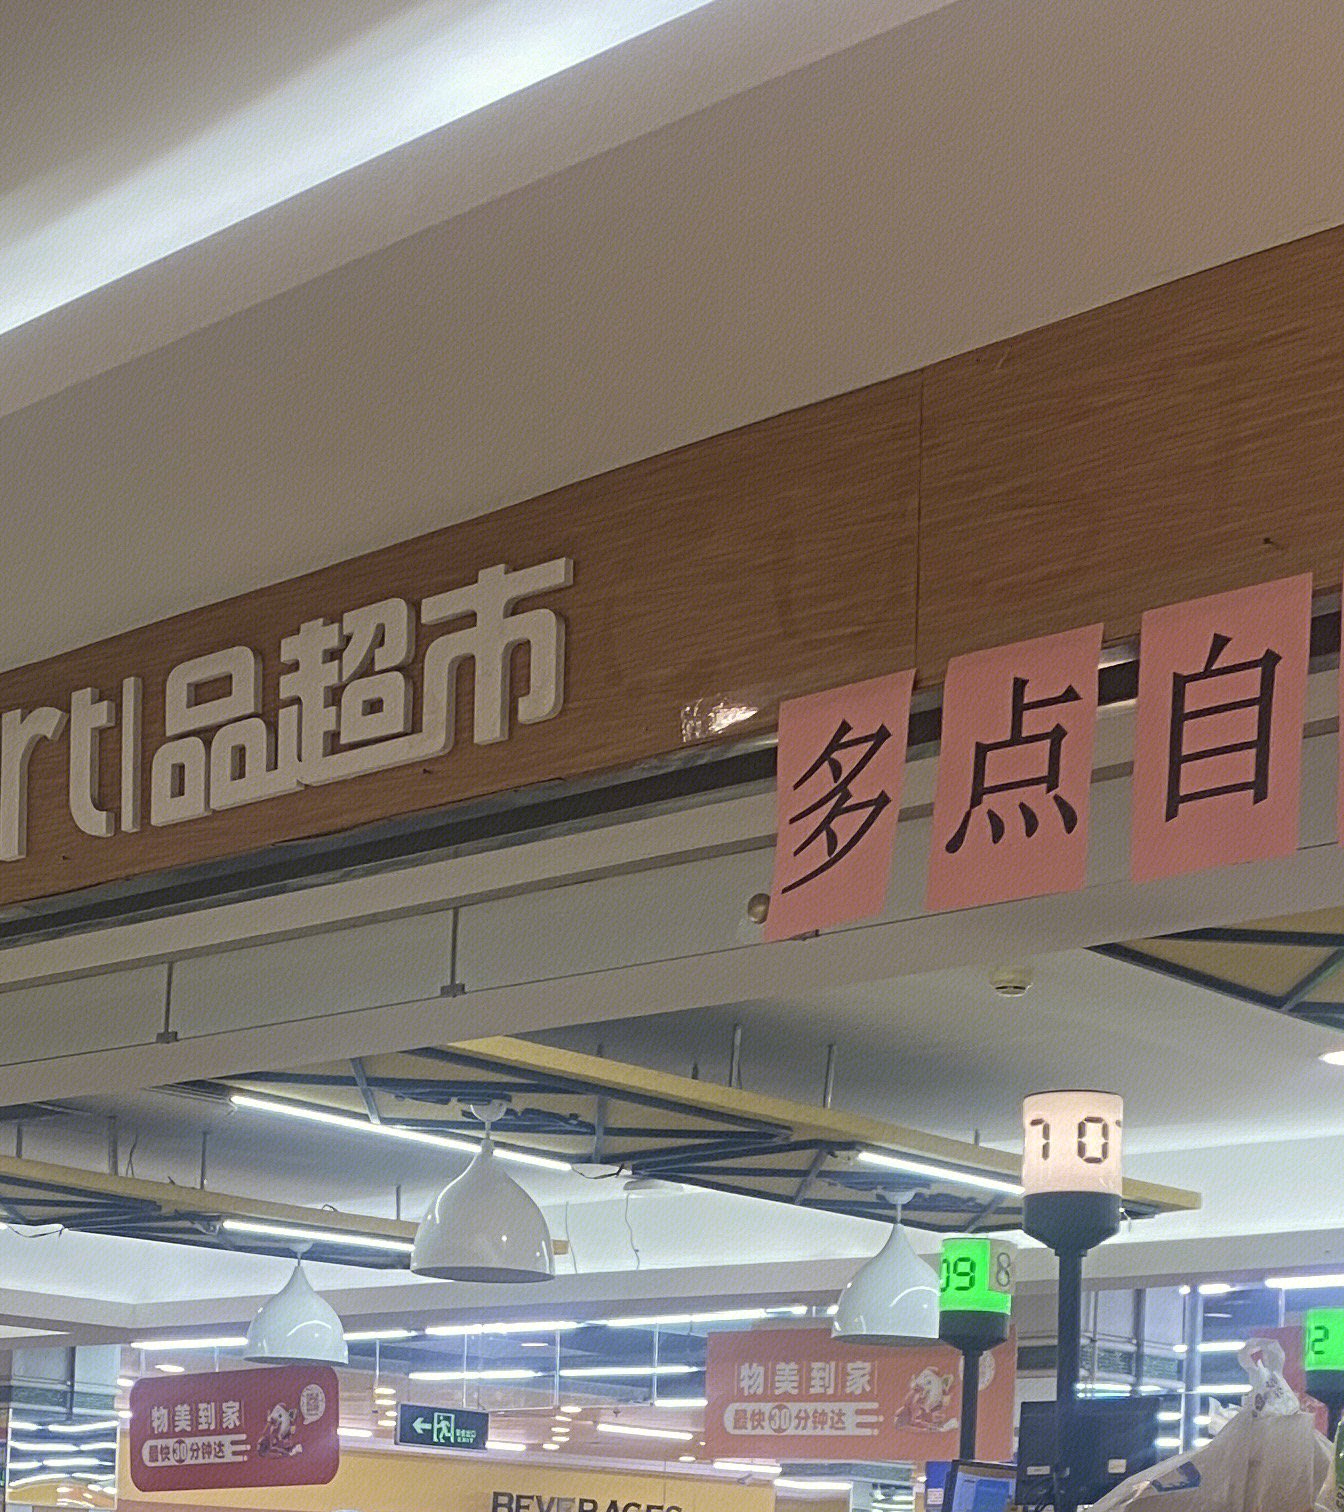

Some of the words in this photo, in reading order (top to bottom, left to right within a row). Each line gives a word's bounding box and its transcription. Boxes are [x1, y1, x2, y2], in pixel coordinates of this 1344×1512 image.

[739, 1361, 872, 1396] 物美到家
[151, 1400, 241, 1433] 物美到家
[732, 1405, 847, 1433] 最快30分钟达
[147, 1440, 226, 1465] 最快30分钟达
